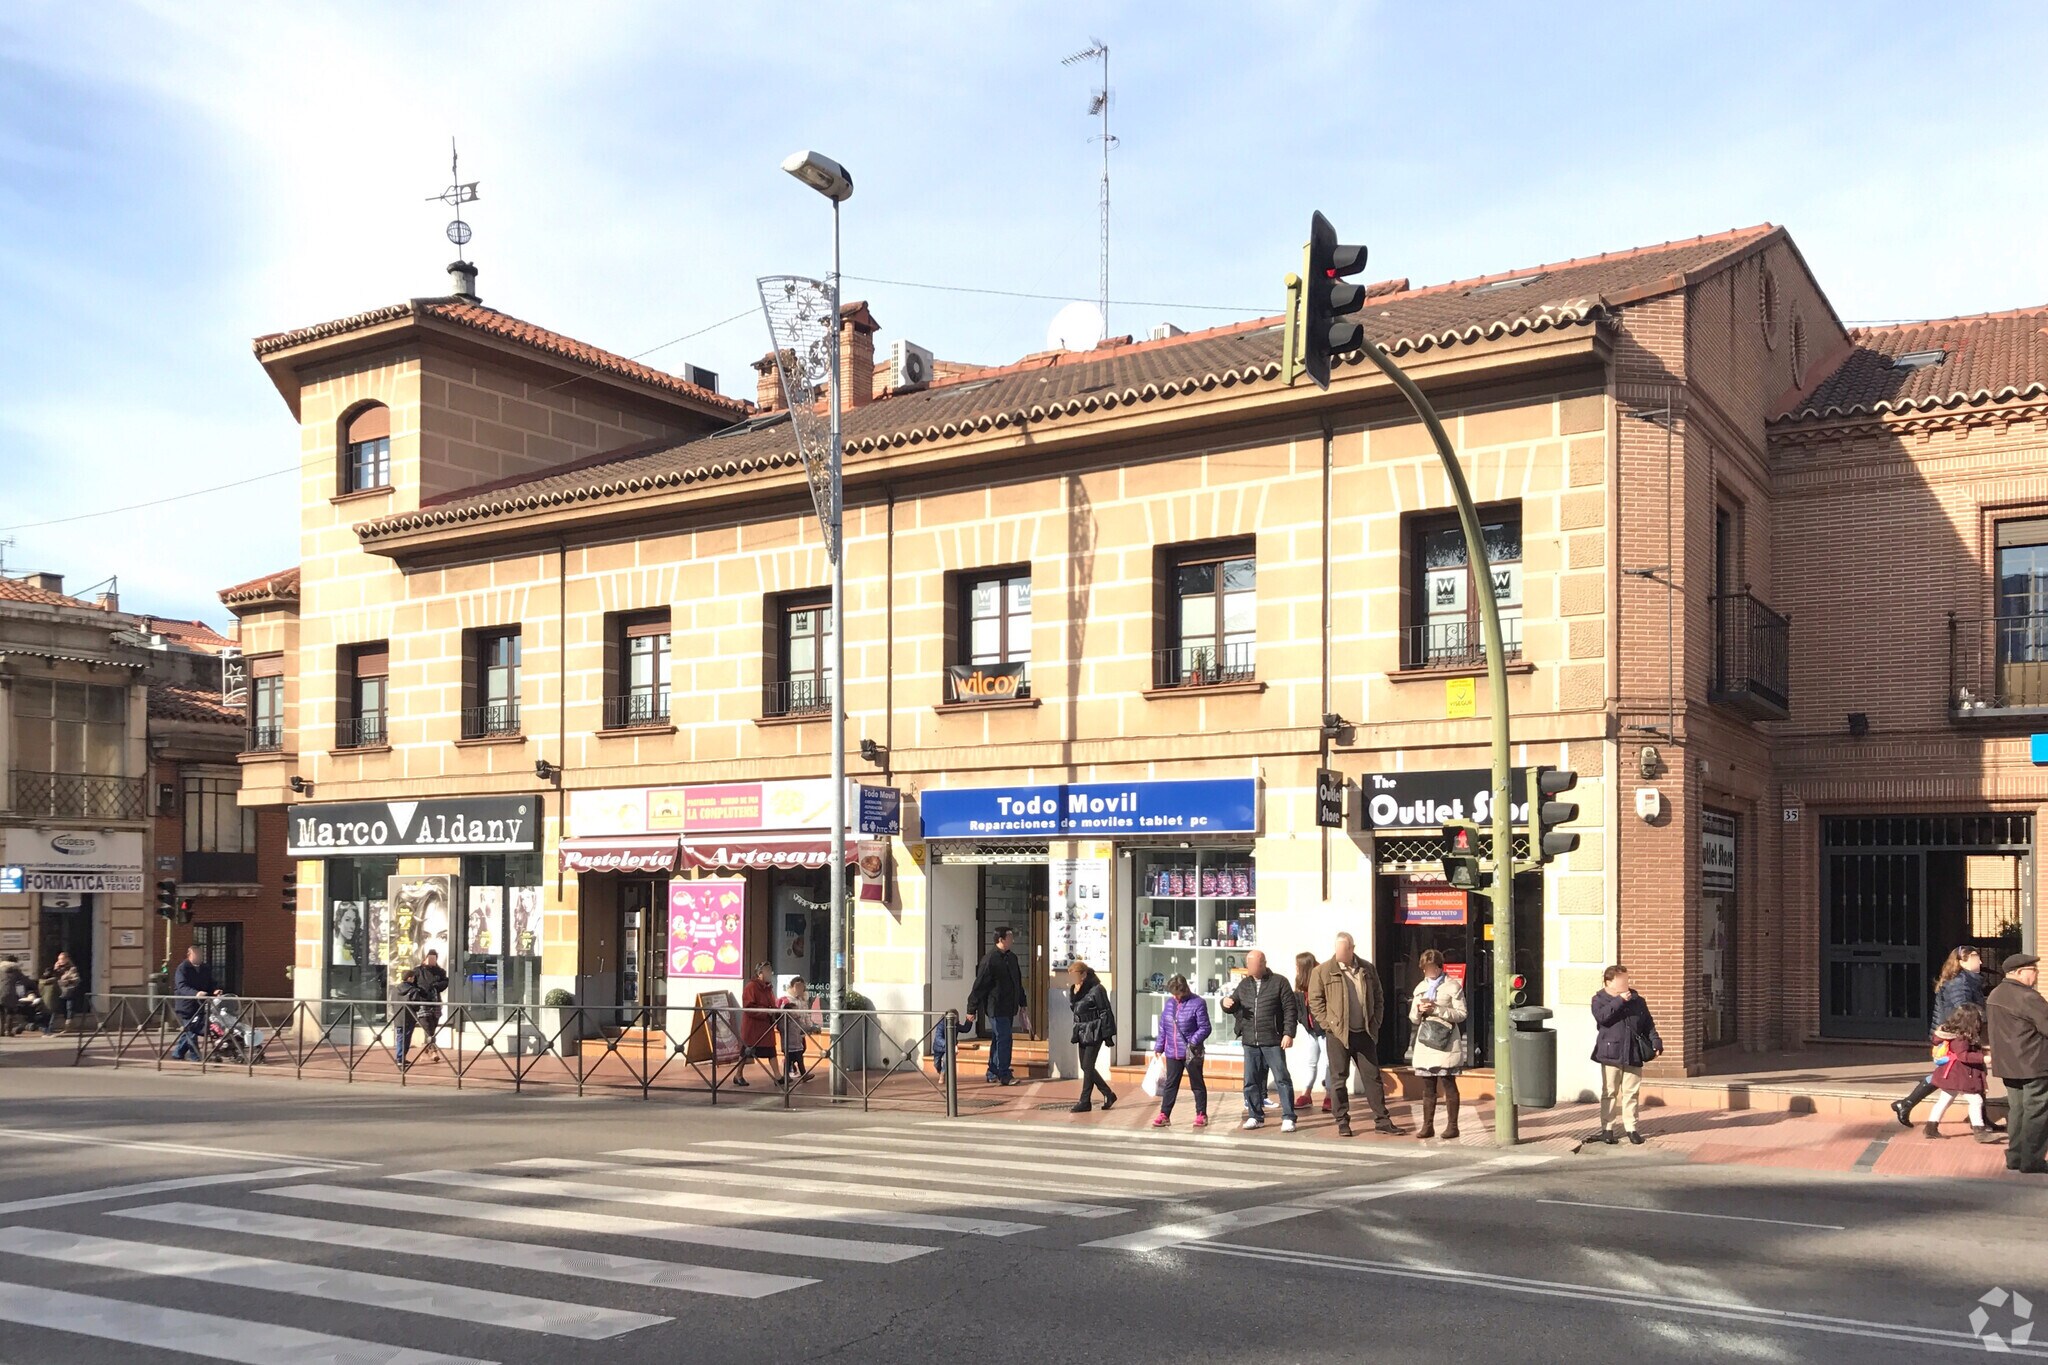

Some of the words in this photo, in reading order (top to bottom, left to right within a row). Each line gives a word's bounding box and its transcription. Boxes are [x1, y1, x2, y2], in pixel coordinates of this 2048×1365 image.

[1372, 775, 1397, 789] The
[864, 789, 879, 798] Todo
[880, 791, 896, 799] Movil
[1320, 784, 1342, 802] Outlet
[687, 808, 697, 819] LA
[700, 806, 759, 819] COMPLUTENSE
[997, 797, 1057, 816] Todo
[1068, 792, 1137, 814] Movil
[1369, 794, 1464, 825] Outlet
[1322, 805, 1340, 823] Store
[1785, 810, 1798, 820] 35
[297, 818, 388, 847] Marco
[415, 814, 523, 843] Aldany
[969, 818, 1055, 832] Reparaciones
[1060, 817, 1077, 828] de
[1081, 816, 1133, 828] moviles
[1140, 815, 1183, 827] tablet
[1190, 817, 1208, 829] pc
[58, 838, 95, 847] CODESYS
[564, 850, 674, 867] Pastelería
[1703, 842, 1717, 865] utlet
[25, 874, 104, 890] FORMATICA
[105, 875, 141, 883] SERVICIO
